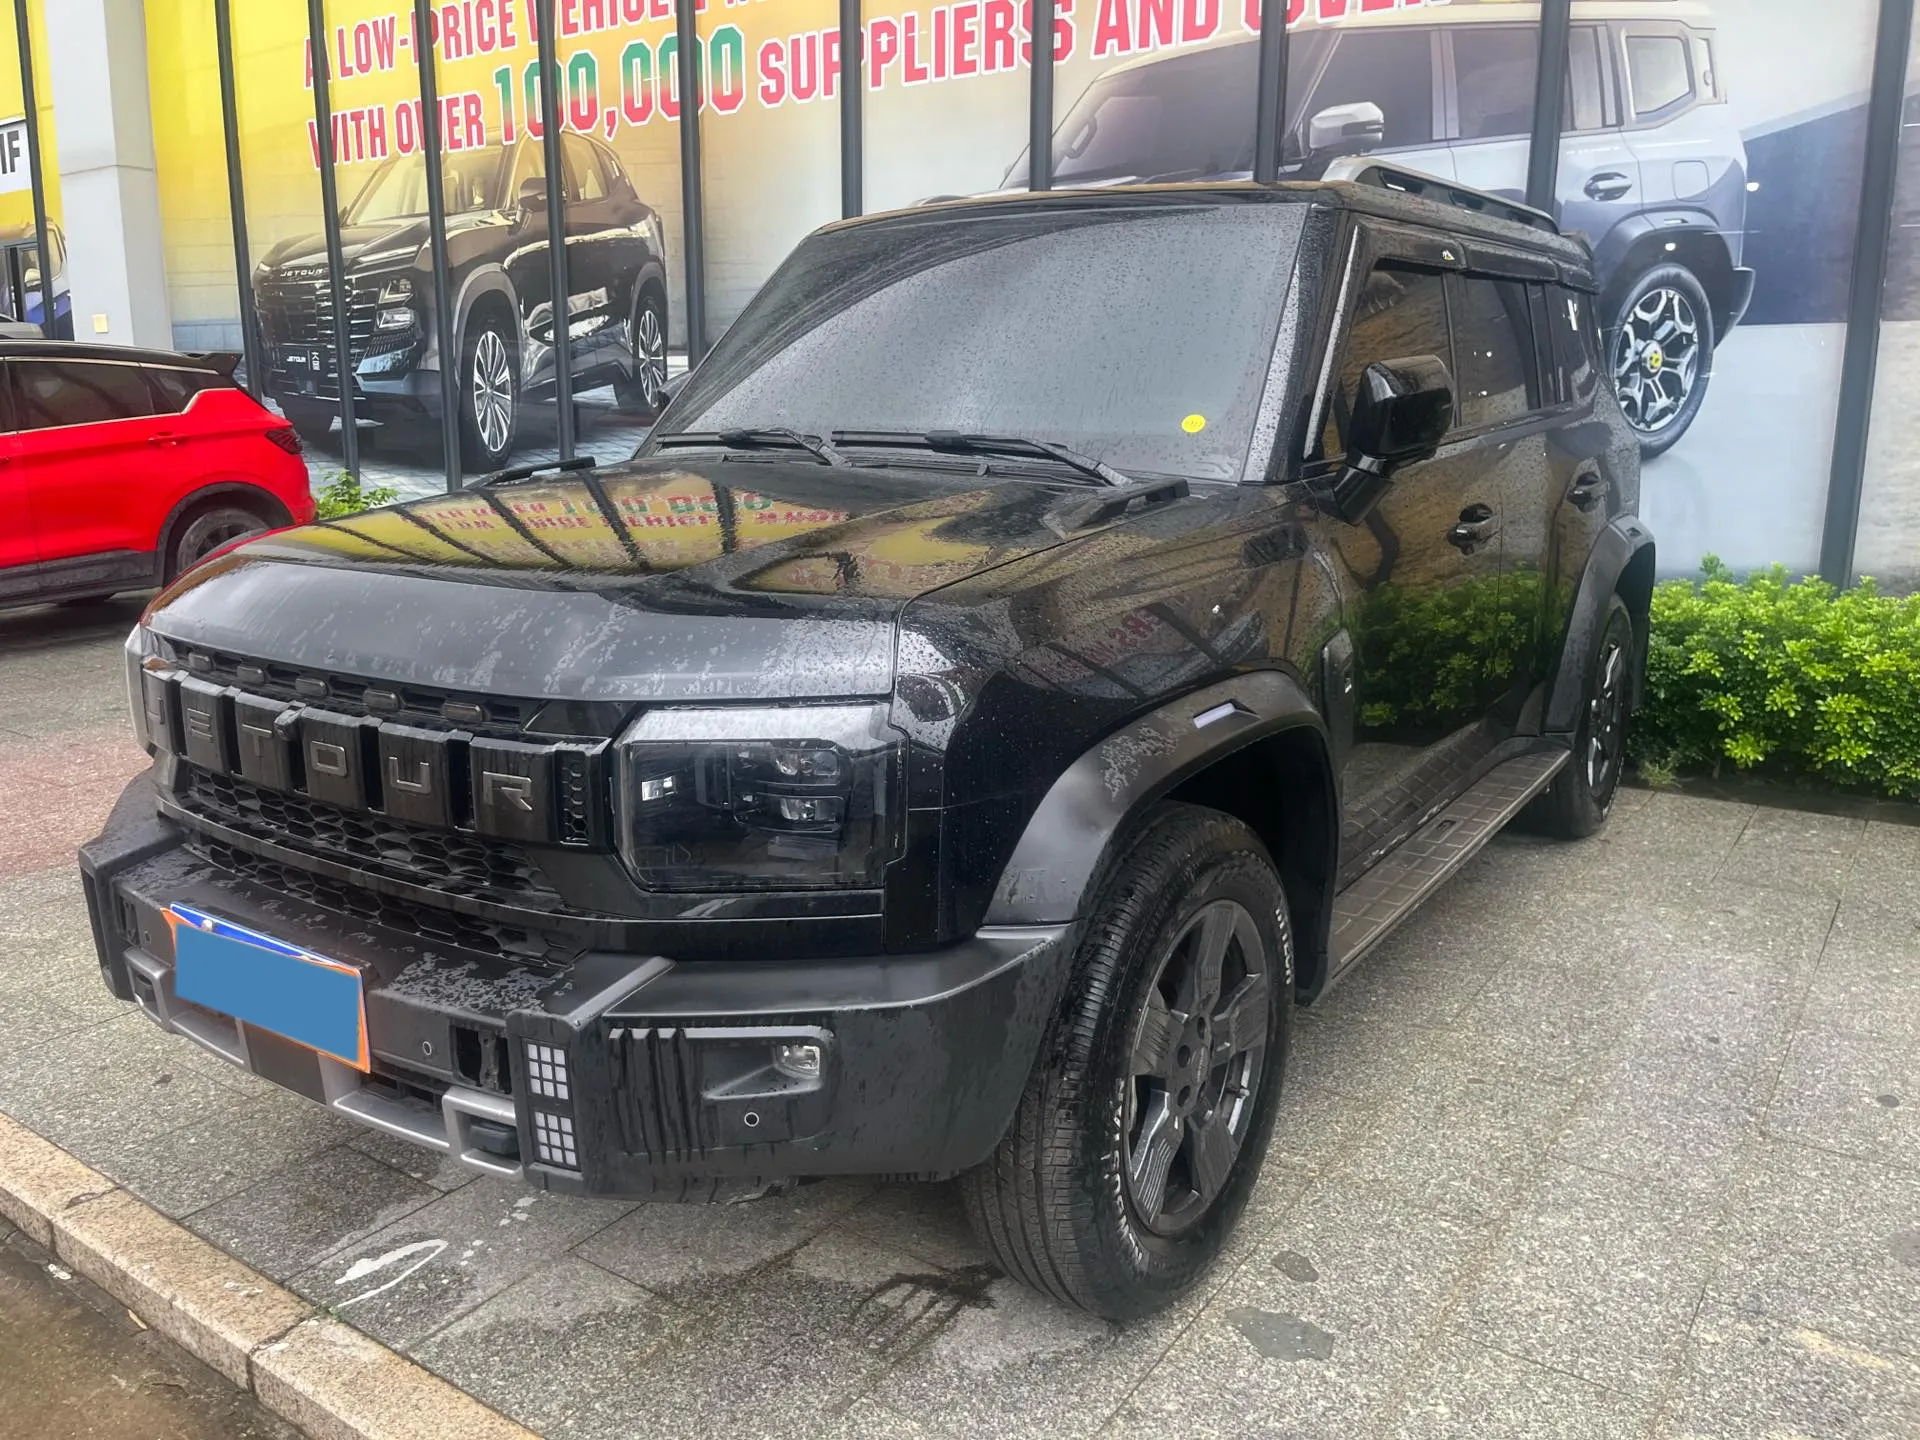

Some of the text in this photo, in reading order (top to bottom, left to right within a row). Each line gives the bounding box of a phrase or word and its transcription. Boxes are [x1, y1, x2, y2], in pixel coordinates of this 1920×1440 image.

[308, 107, 387, 168] WITH
[395, 94, 484, 154] OVER
[495, 26, 745, 142] 100,000
[760, 0, 1073, 105] SUPPLIERS
[1094, 0, 1218, 55] AND
[337, 0, 516, 78] LOW-PRICE
[280, 268, 324, 277] JETOUR
[148, 696, 533, 811] JETOUR
